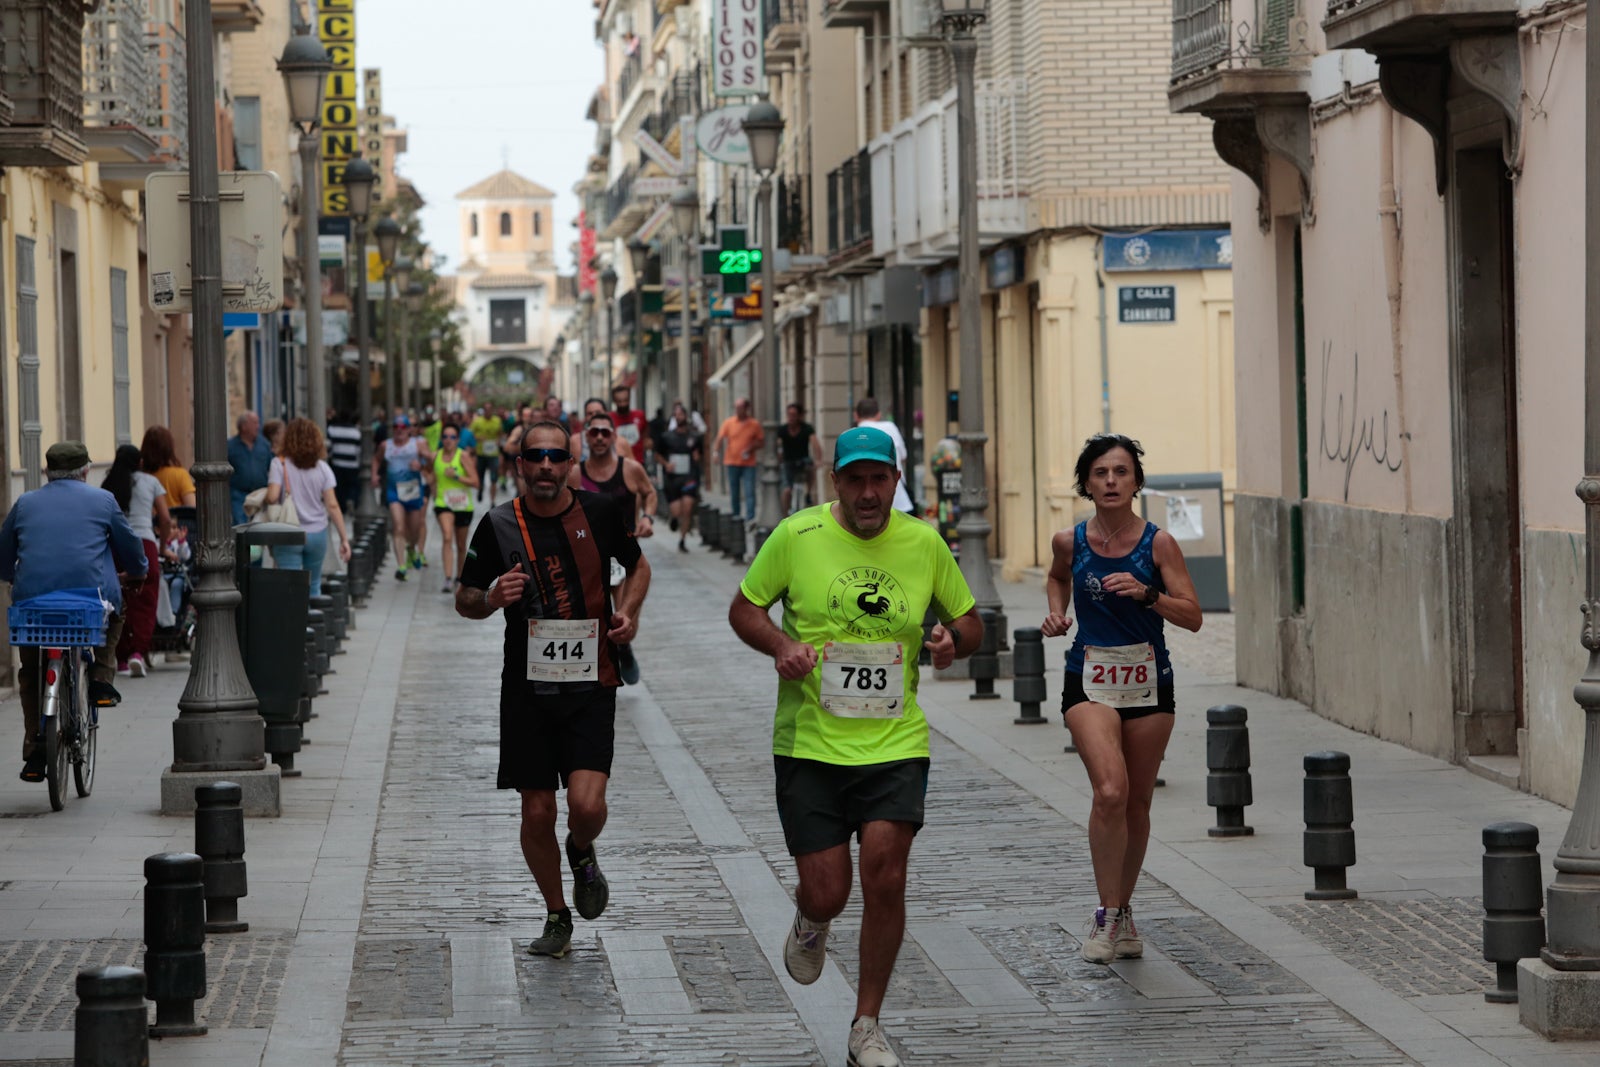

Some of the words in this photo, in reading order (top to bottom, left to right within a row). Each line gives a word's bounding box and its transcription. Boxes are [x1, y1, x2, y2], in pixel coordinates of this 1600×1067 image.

[1136, 287, 1170, 299] CALLE
[838, 569, 859, 586] BAR
[864, 568, 896, 592] SORIA
[543, 641, 584, 660] 414
[841, 666, 887, 690] 783
[1092, 665, 1148, 685] 2178
